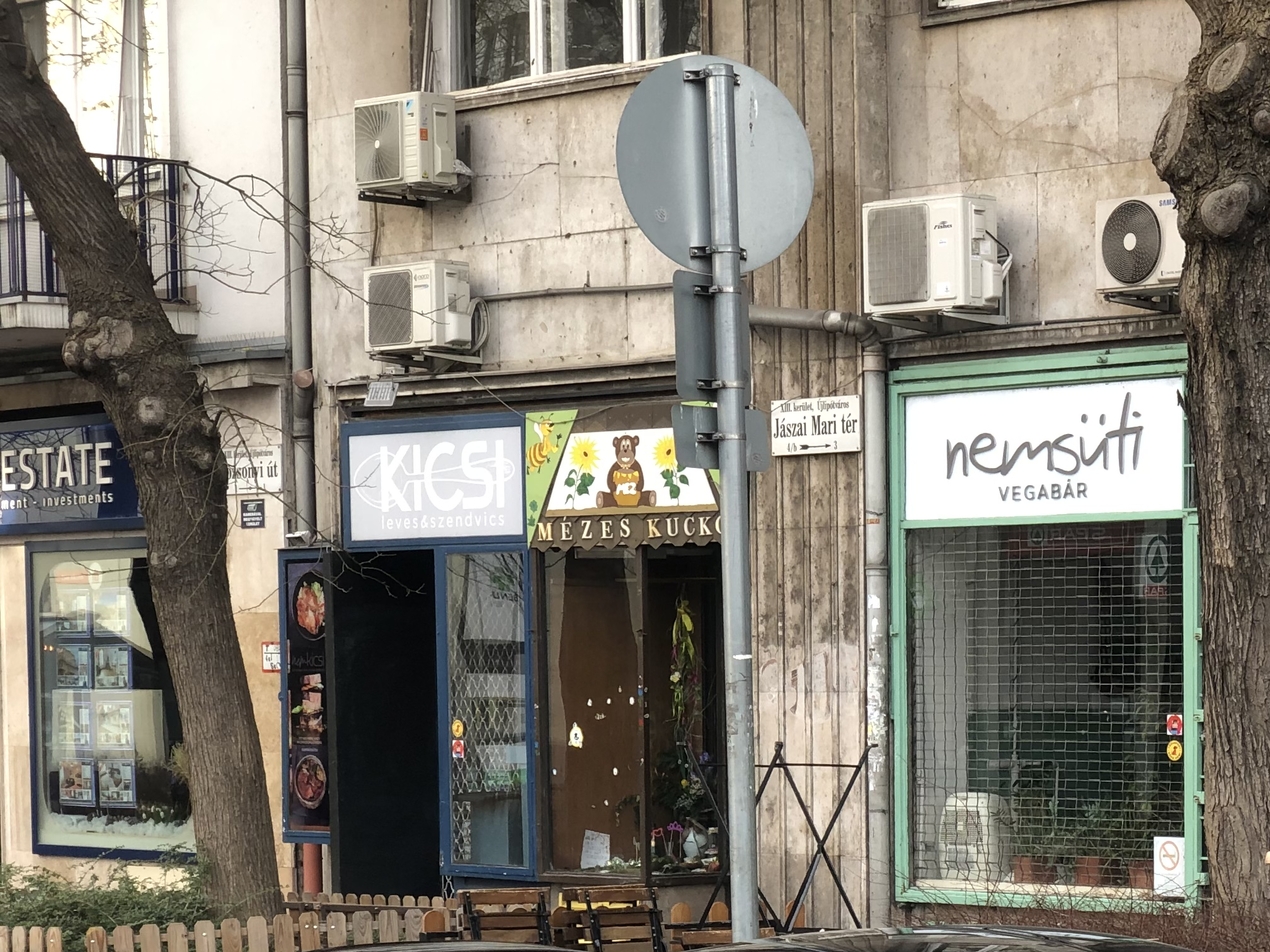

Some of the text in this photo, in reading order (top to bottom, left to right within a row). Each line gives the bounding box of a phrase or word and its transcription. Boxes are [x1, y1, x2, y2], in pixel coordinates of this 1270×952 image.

[1159, 199, 1176, 207] SAMS
[773, 413, 858, 439] Jászai Mari tér
[945, 391, 1144, 480] nemsüti
[834, 440, 838, 450] 3
[0, 441, 114, 492] ESTATE
[228, 460, 279, 480] ozsonyi út
[379, 439, 505, 513] KICSI
[0, 496, 28, 510] ment
[42, 491, 114, 507] investments
[998, 478, 1089, 502] VEGABÁR
[381, 511, 505, 531] leves&szendvics
[537, 516, 631, 542] MÉZES
